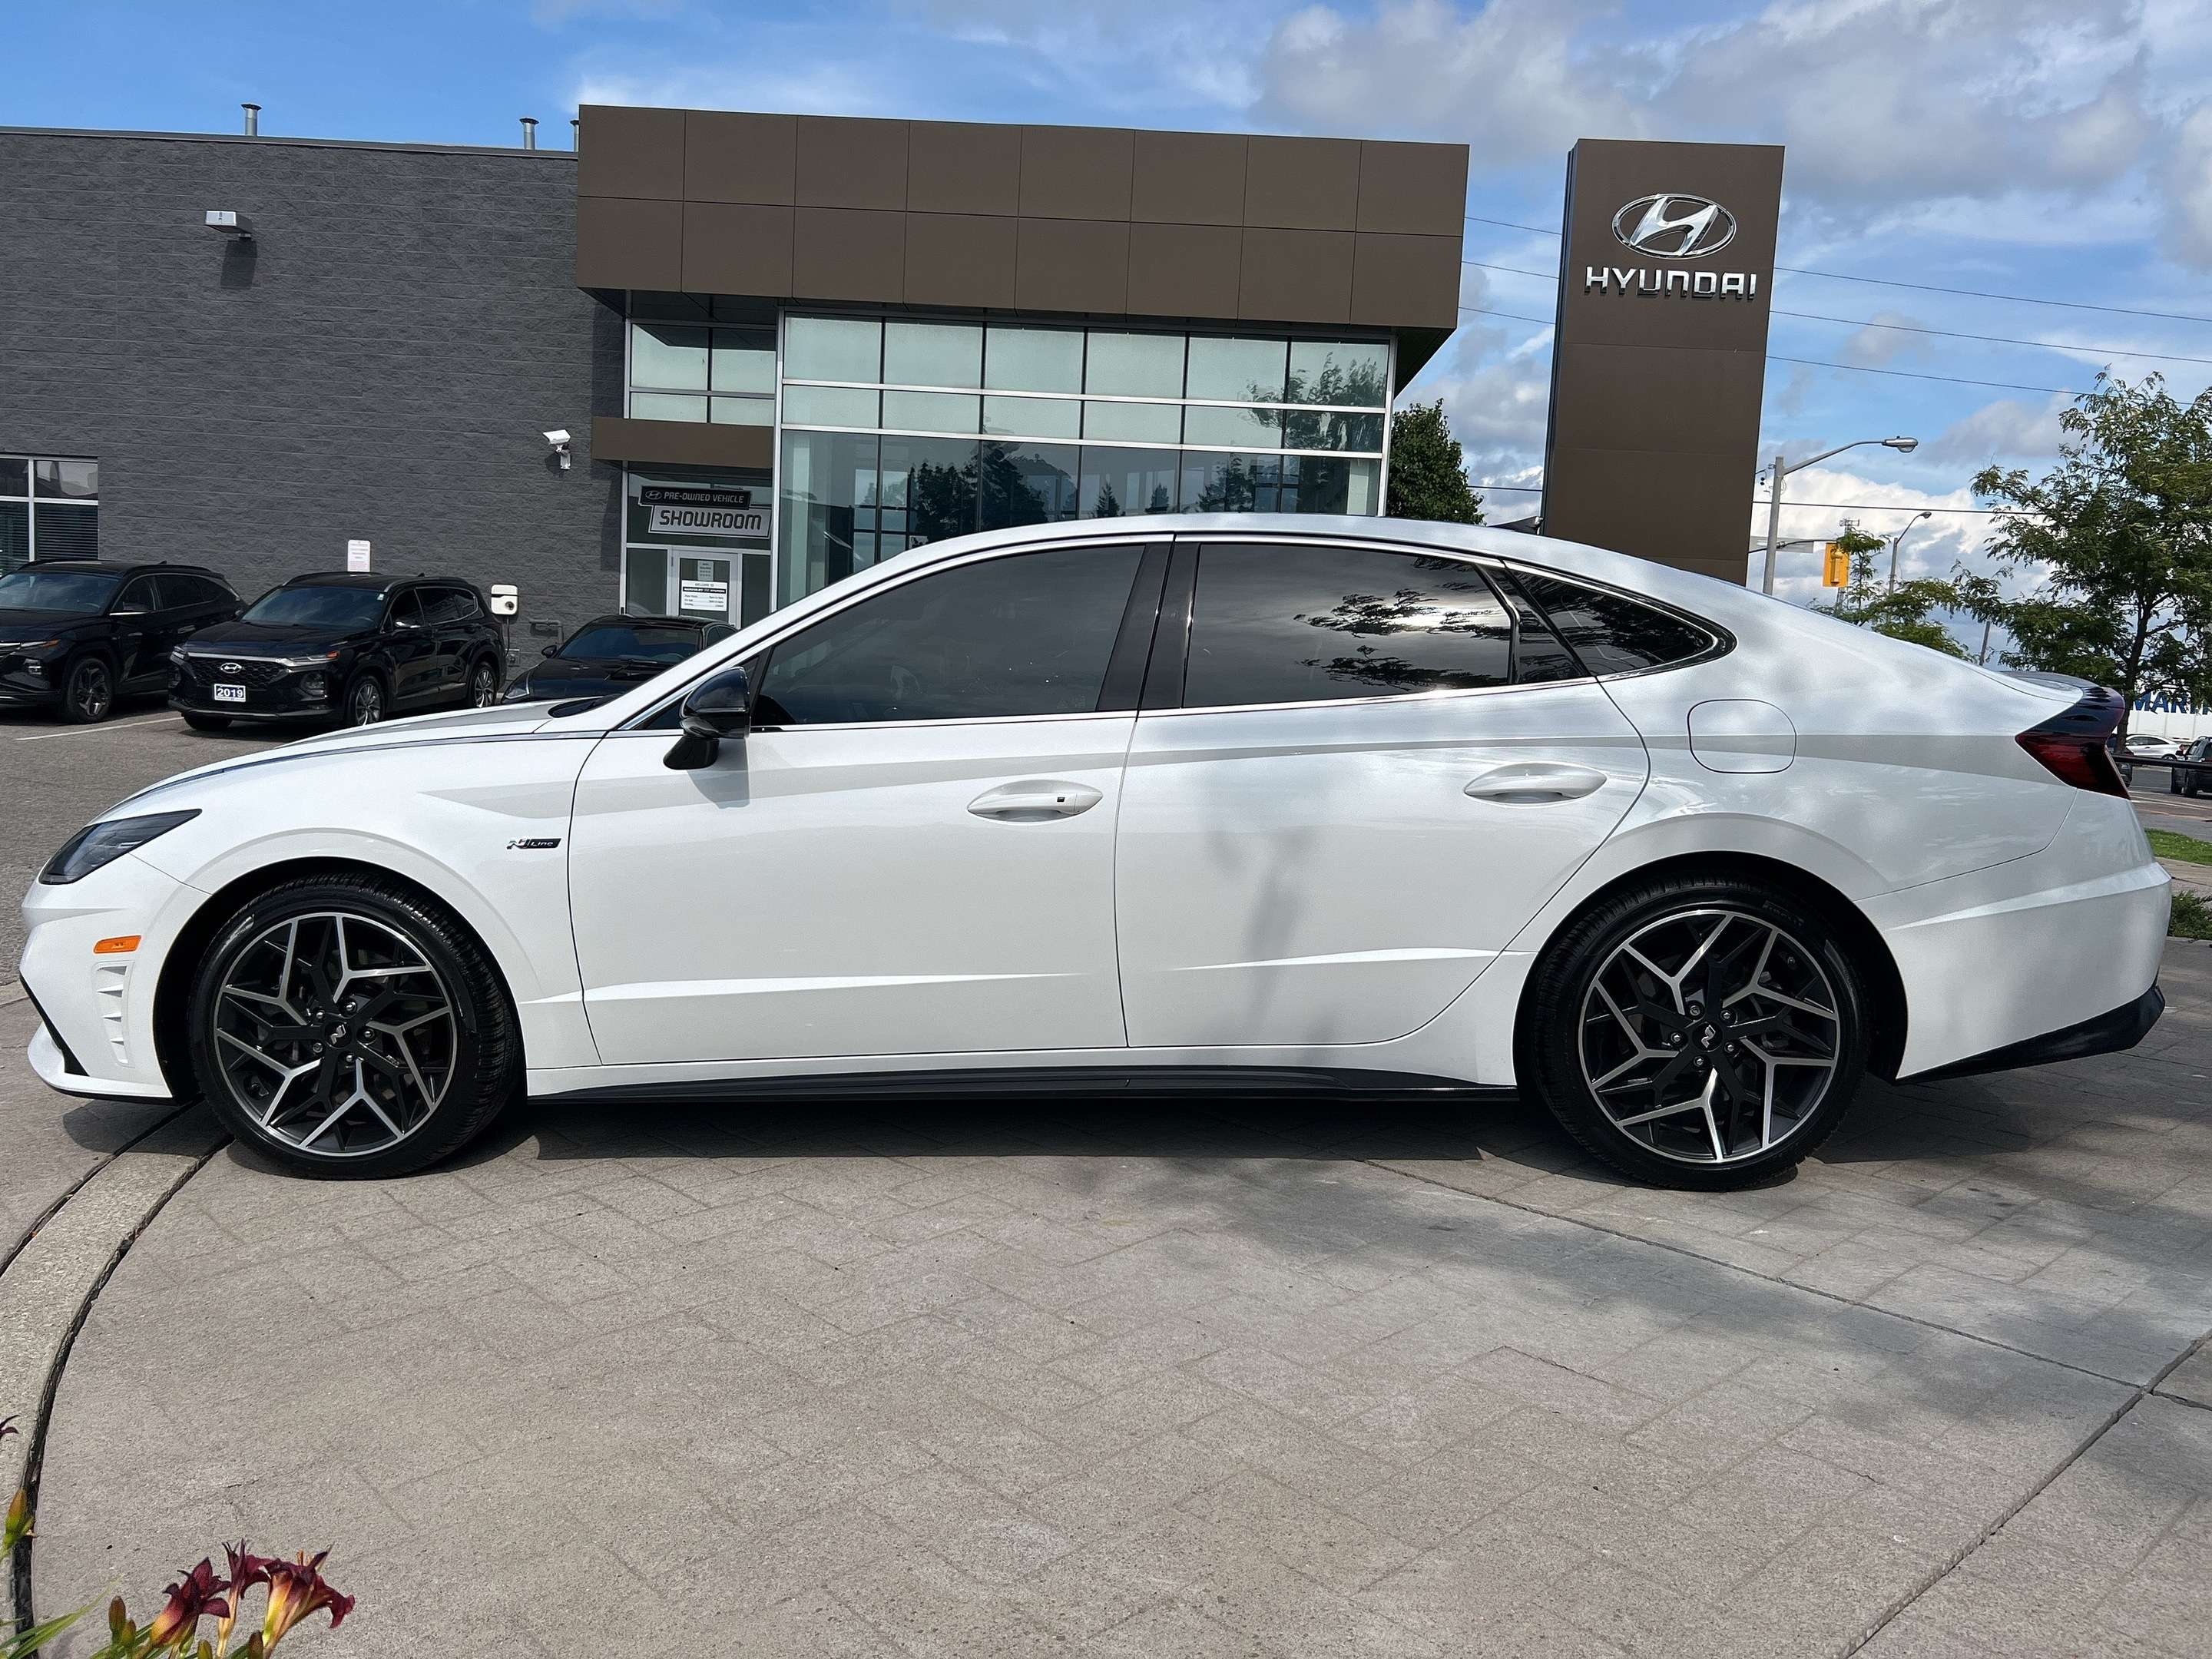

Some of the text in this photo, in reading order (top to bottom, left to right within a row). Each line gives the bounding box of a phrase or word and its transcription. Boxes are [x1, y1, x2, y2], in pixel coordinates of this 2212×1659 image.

[1584, 267, 1757, 300] HYUNDAI
[664, 492, 744, 504] PRE-OWNED VEHICLE
[659, 509, 762, 530] SHOWROOM
[217, 688, 243, 697] 2019
